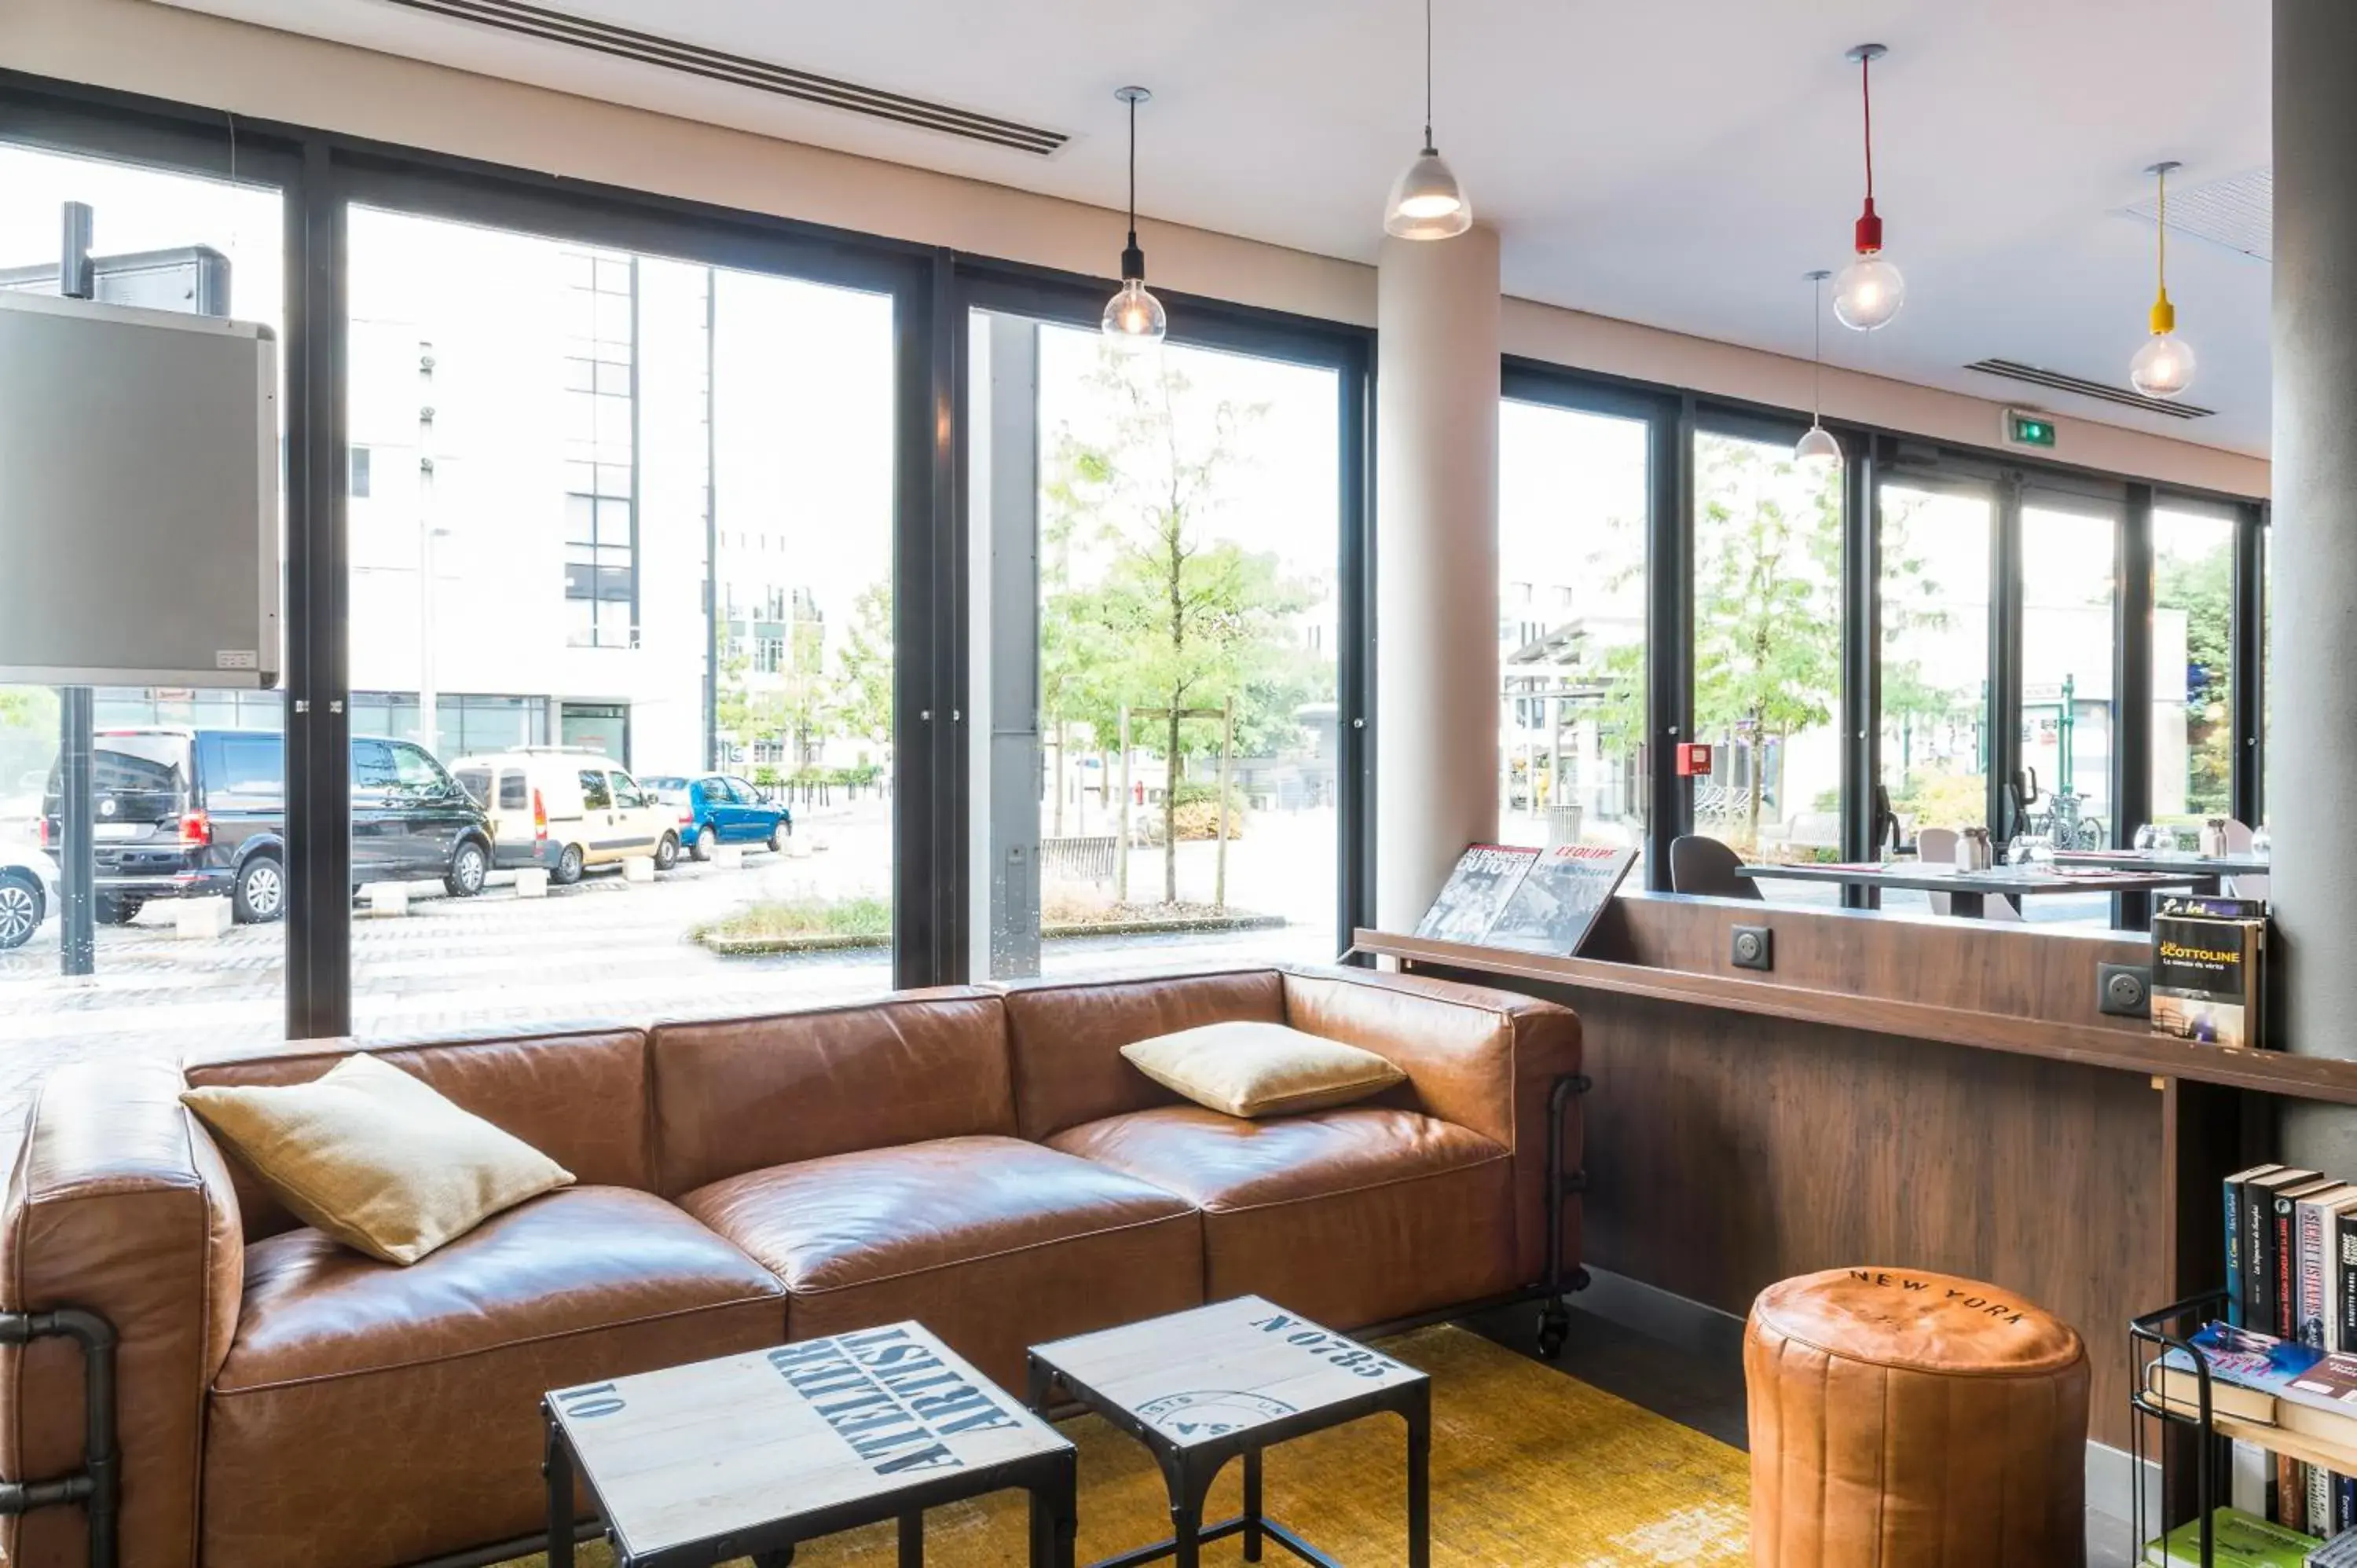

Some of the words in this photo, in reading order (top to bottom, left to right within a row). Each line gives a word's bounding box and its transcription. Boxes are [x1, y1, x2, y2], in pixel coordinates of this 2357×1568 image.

[2160, 946, 2242, 963] SCOTTOLINE
[1848, 1269, 1930, 1292] NEW
[1945, 1288, 2028, 1326] YORK
[1248, 1315, 1302, 1332] N
[1286, 1331, 1400, 1378] 0785
[766, 1337, 965, 1476] ATELIER
[837, 1328, 1022, 1437] ARTIST
